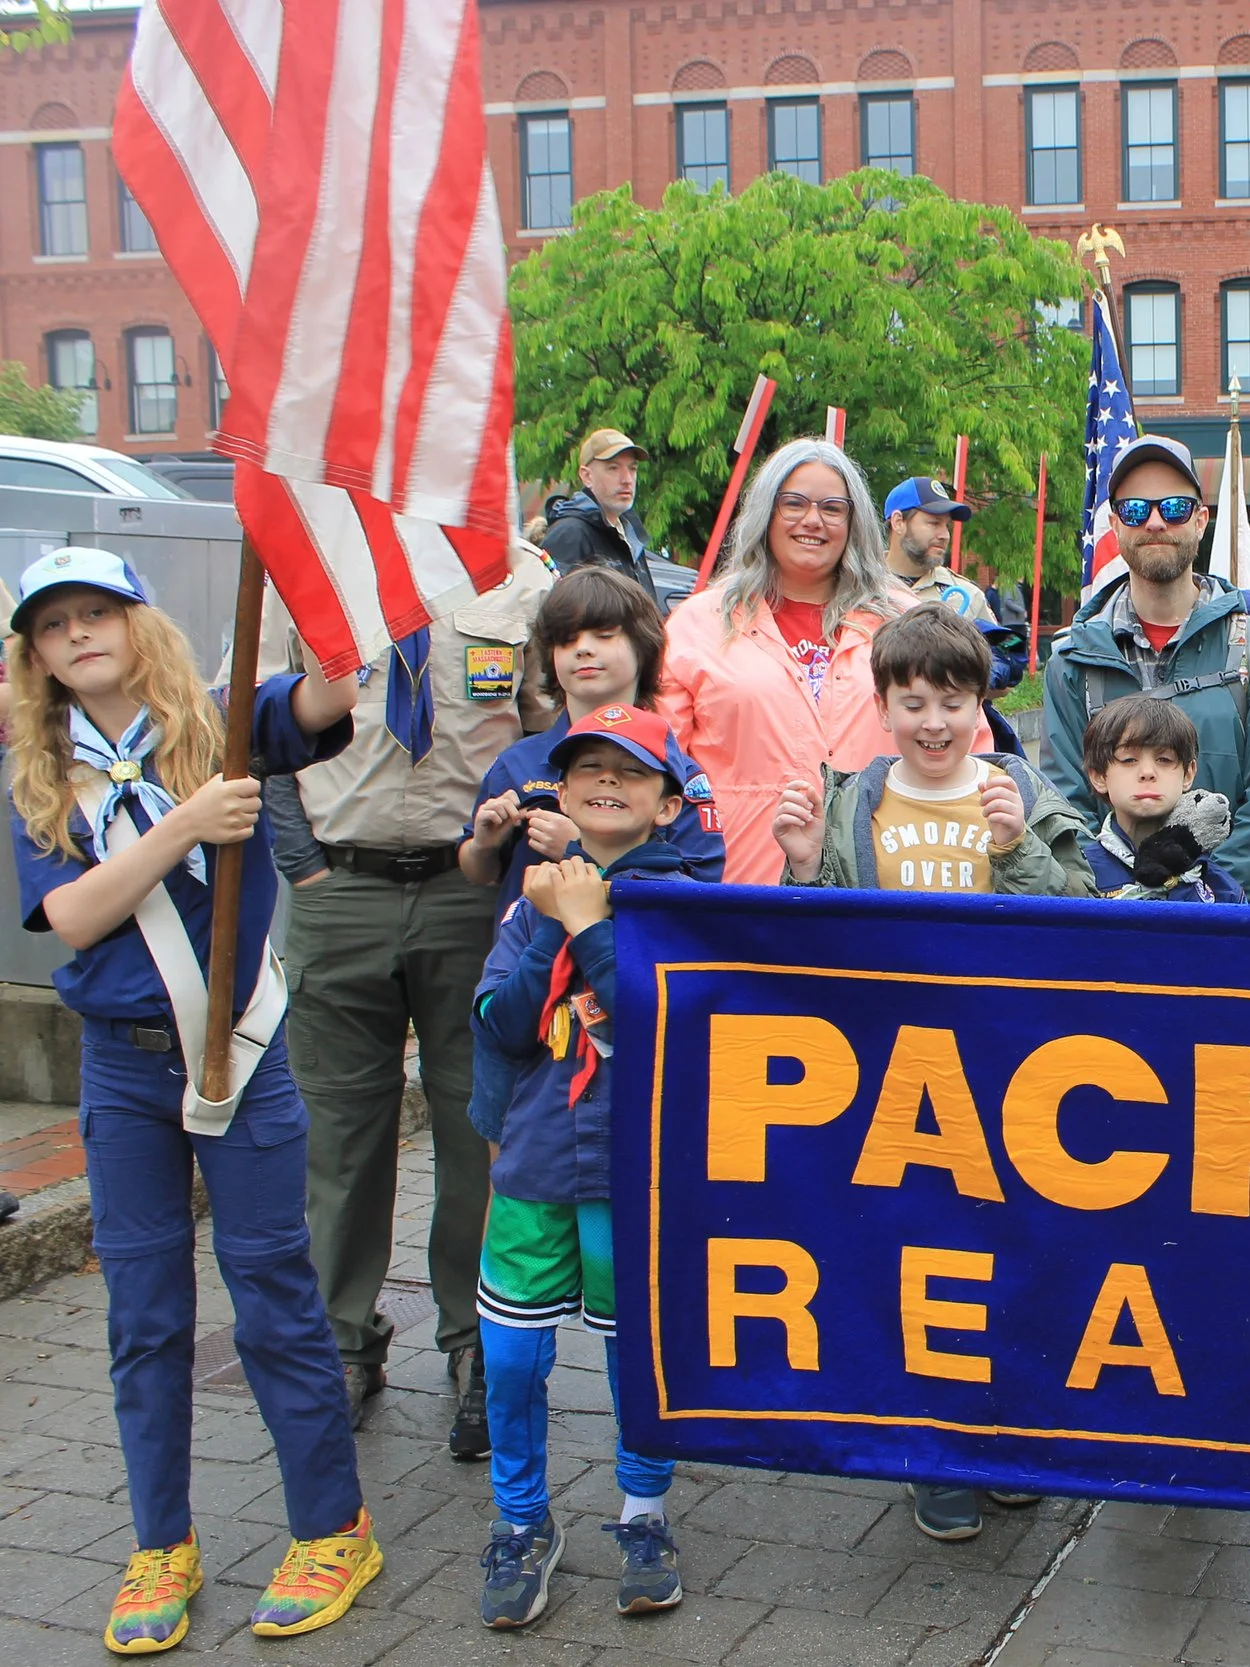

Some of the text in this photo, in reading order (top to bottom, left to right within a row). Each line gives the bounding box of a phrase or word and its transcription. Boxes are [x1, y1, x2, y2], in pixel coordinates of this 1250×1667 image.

[535, 780, 559, 791] BSA
[880, 821, 993, 854] S'MORES
[900, 860, 974, 888] OVER
